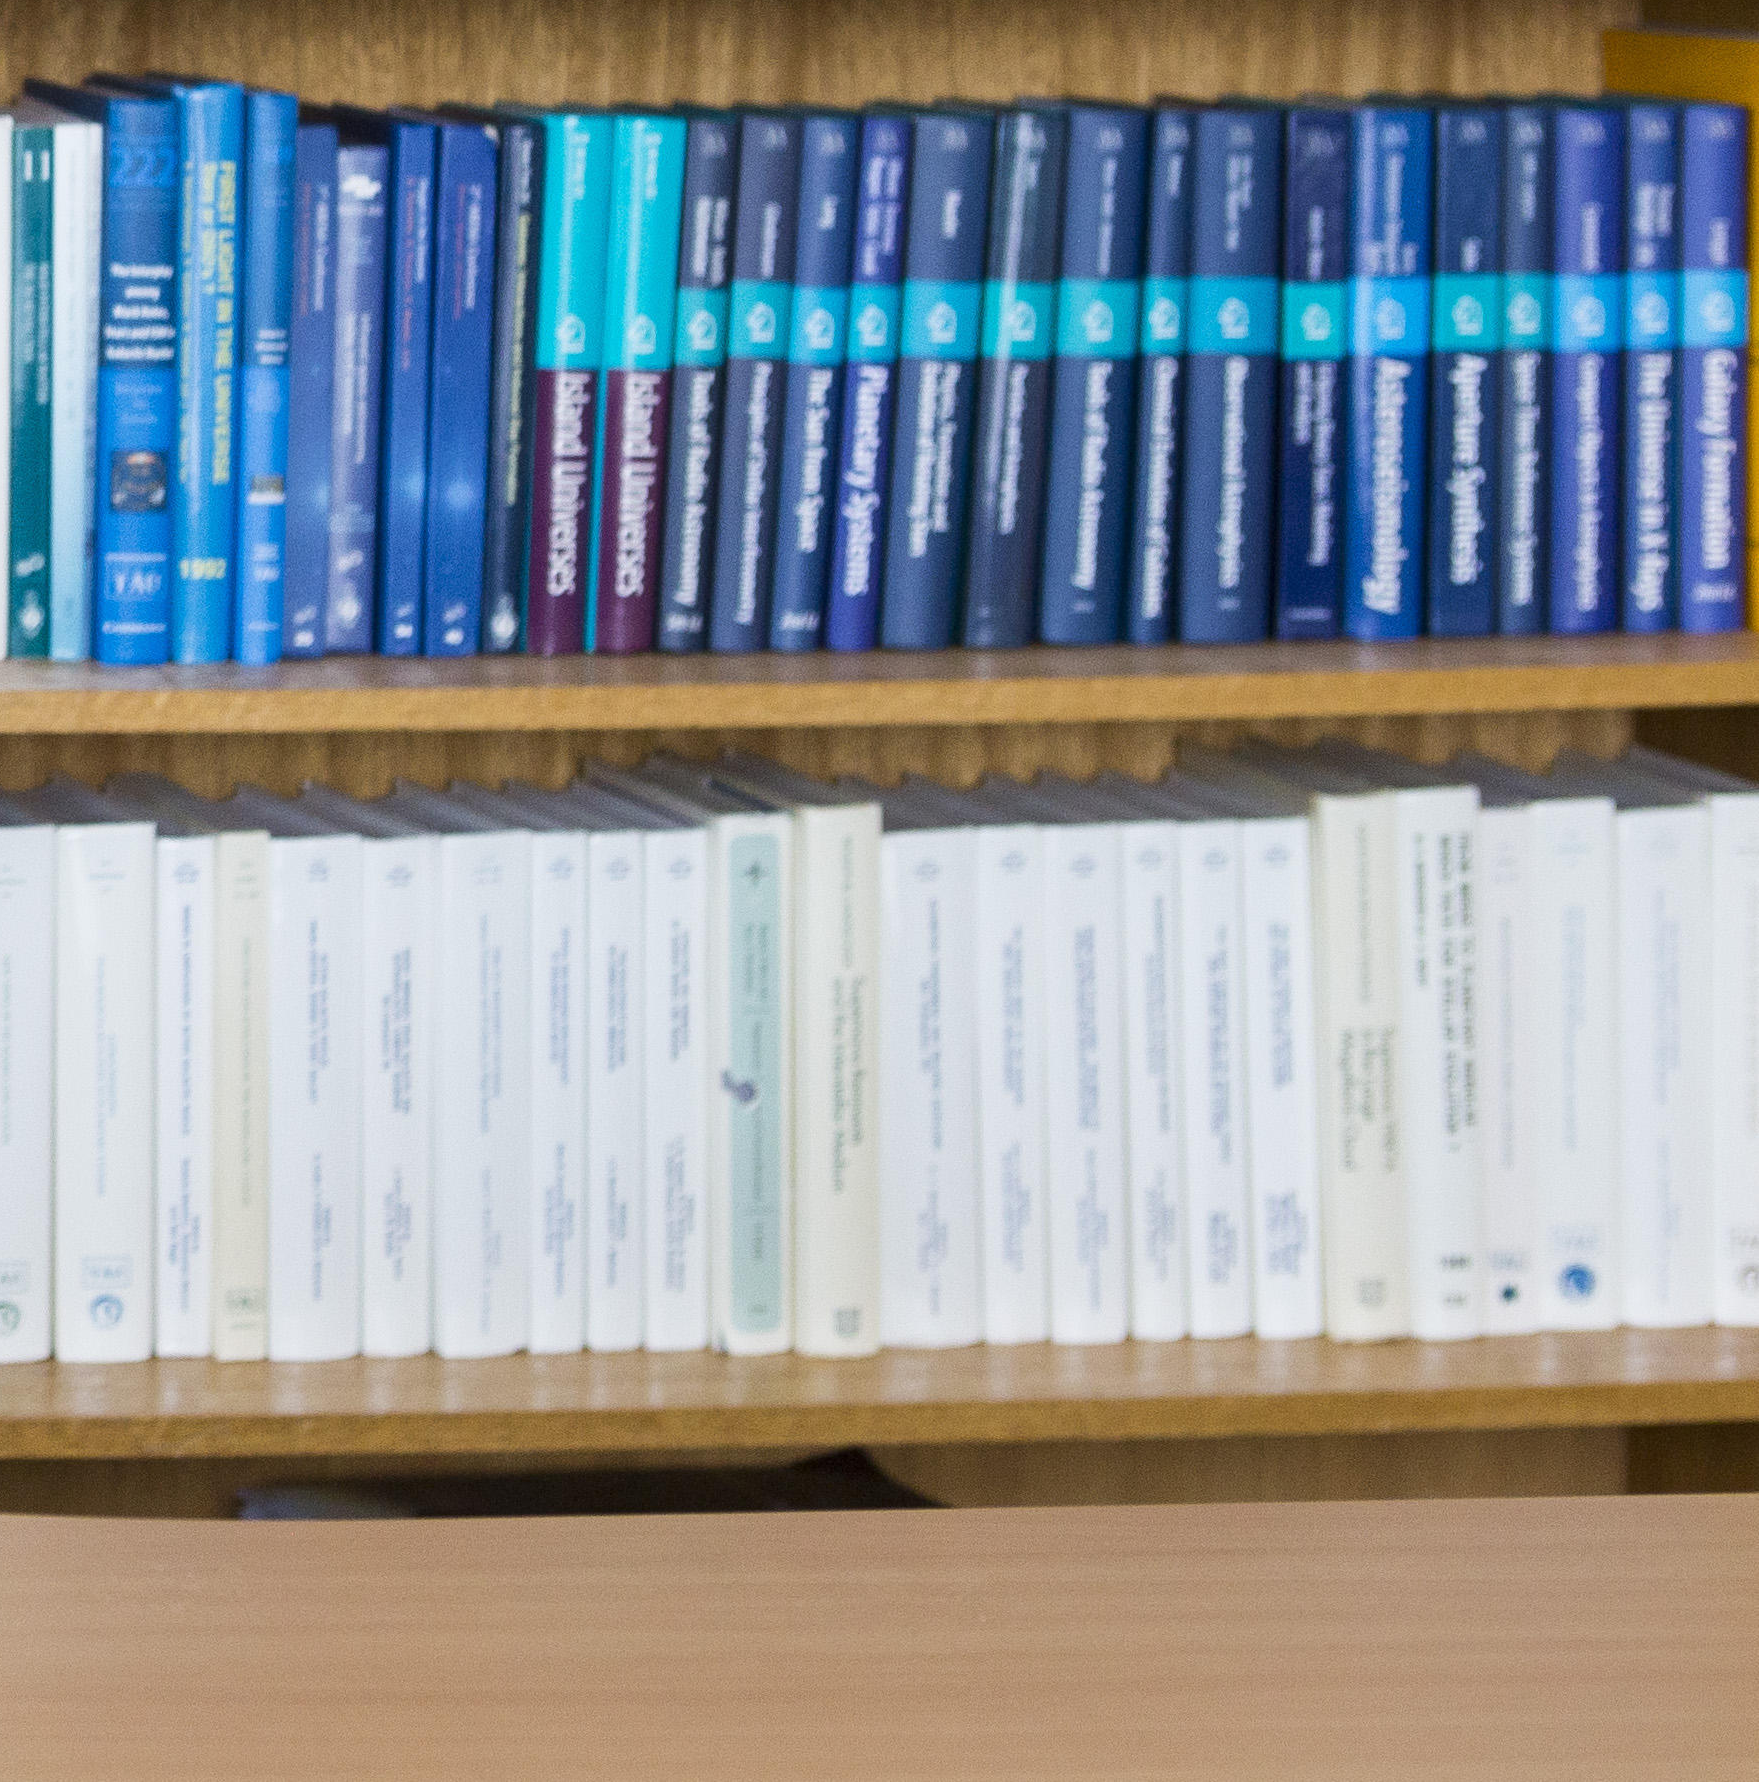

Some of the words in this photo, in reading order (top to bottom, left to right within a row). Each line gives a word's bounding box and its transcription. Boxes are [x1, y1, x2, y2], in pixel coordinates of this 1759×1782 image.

[218, 160, 236, 224] FIRST
[217, 228, 234, 293] LIGHT
[215, 327, 232, 369] THE
[217, 298, 232, 323] IN
[556, 372, 591, 457] Island
[624, 372, 660, 457] Island
[808, 370, 832, 404] The
[1446, 352, 1487, 464] Aperture
[1640, 352, 1672, 394] The
[1696, 349, 1736, 435] Galaxy
[213, 374, 229, 484] UNIVERSE
[803, 445, 827, 490] from
[806, 408, 830, 442] Sun
[845, 366, 887, 489] Planetary
[1639, 399, 1671, 501] Universe
[546, 460, 586, 598] Universes
[615, 460, 655, 598] Universes
[795, 493, 824, 553] Space
[1362, 356, 1412, 616] Asteroseismology
[1445, 466, 1486, 585] Synthesis
[1639, 505, 1670, 527] in
[1701, 438, 1737, 570] Formation
[678, 502, 708, 607] Astronomy
[842, 491, 879, 597] Systems
[1070, 490, 1104, 590] Astronomy
